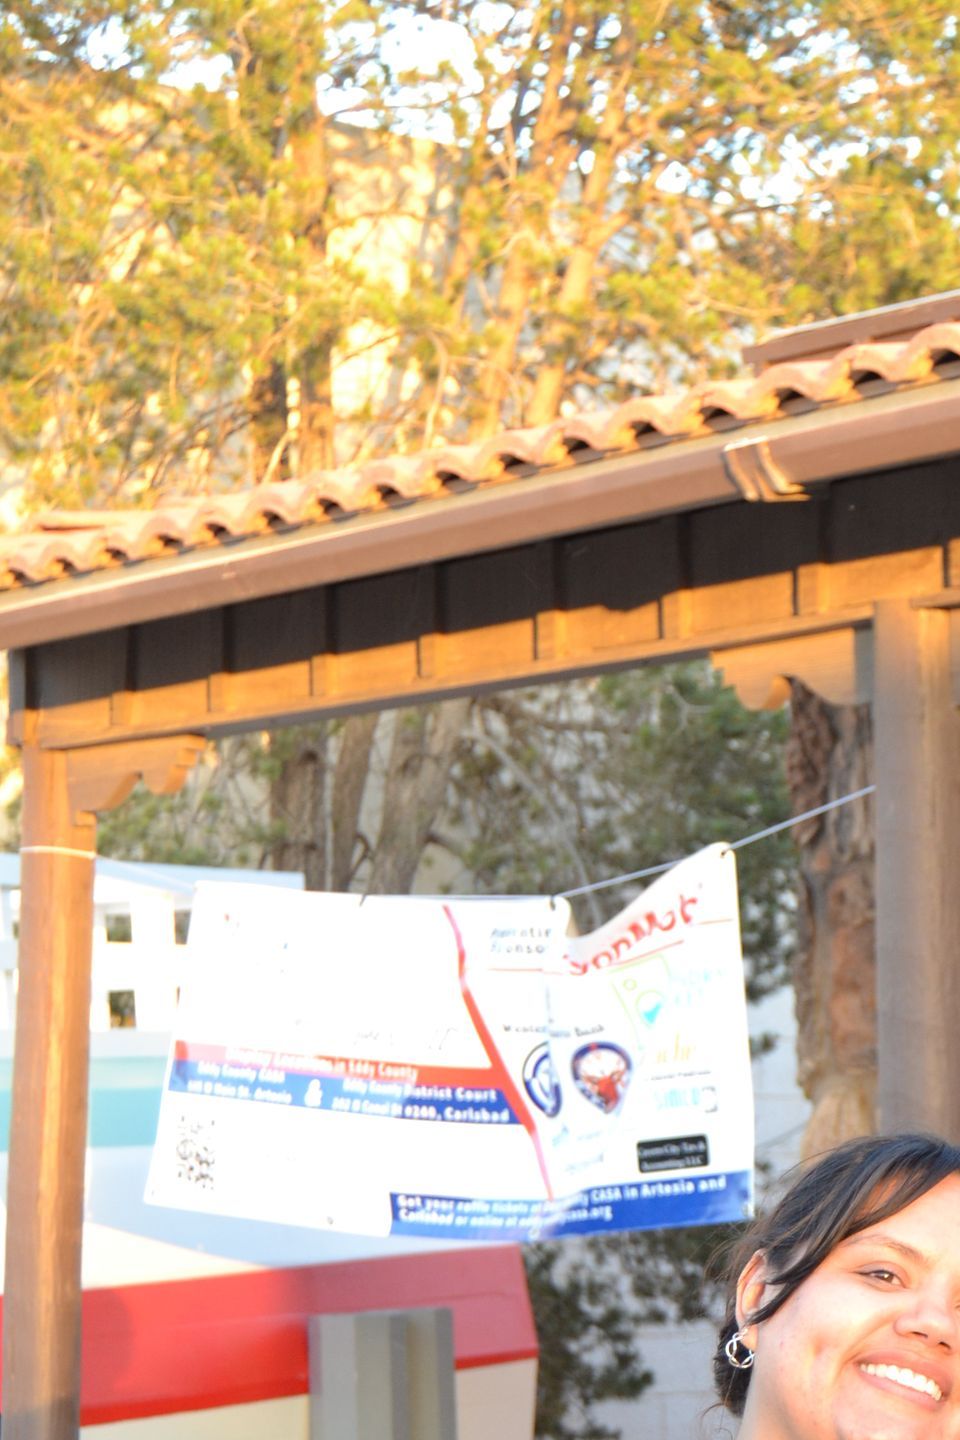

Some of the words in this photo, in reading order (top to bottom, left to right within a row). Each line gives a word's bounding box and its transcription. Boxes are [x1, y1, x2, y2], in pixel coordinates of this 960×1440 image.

[348, 1061, 375, 1078] Eddy
[378, 1063, 415, 1081] County
[304, 1078, 323, 1107] &
[403, 1083, 452, 1101] District
[454, 1087, 496, 1103] Court
[443, 1106, 509, 1123] Carlsbad
[397, 1195, 421, 1208] Get
[426, 1199, 453, 1212] your
[590, 1188, 621, 1203] CASA
[624, 1186, 639, 1200] in
[640, 1180, 694, 1199] Artesia
[699, 1175, 726, 1192] and
[399, 1208, 453, 1226] Carlsbad
[454, 1216, 467, 1226] or
